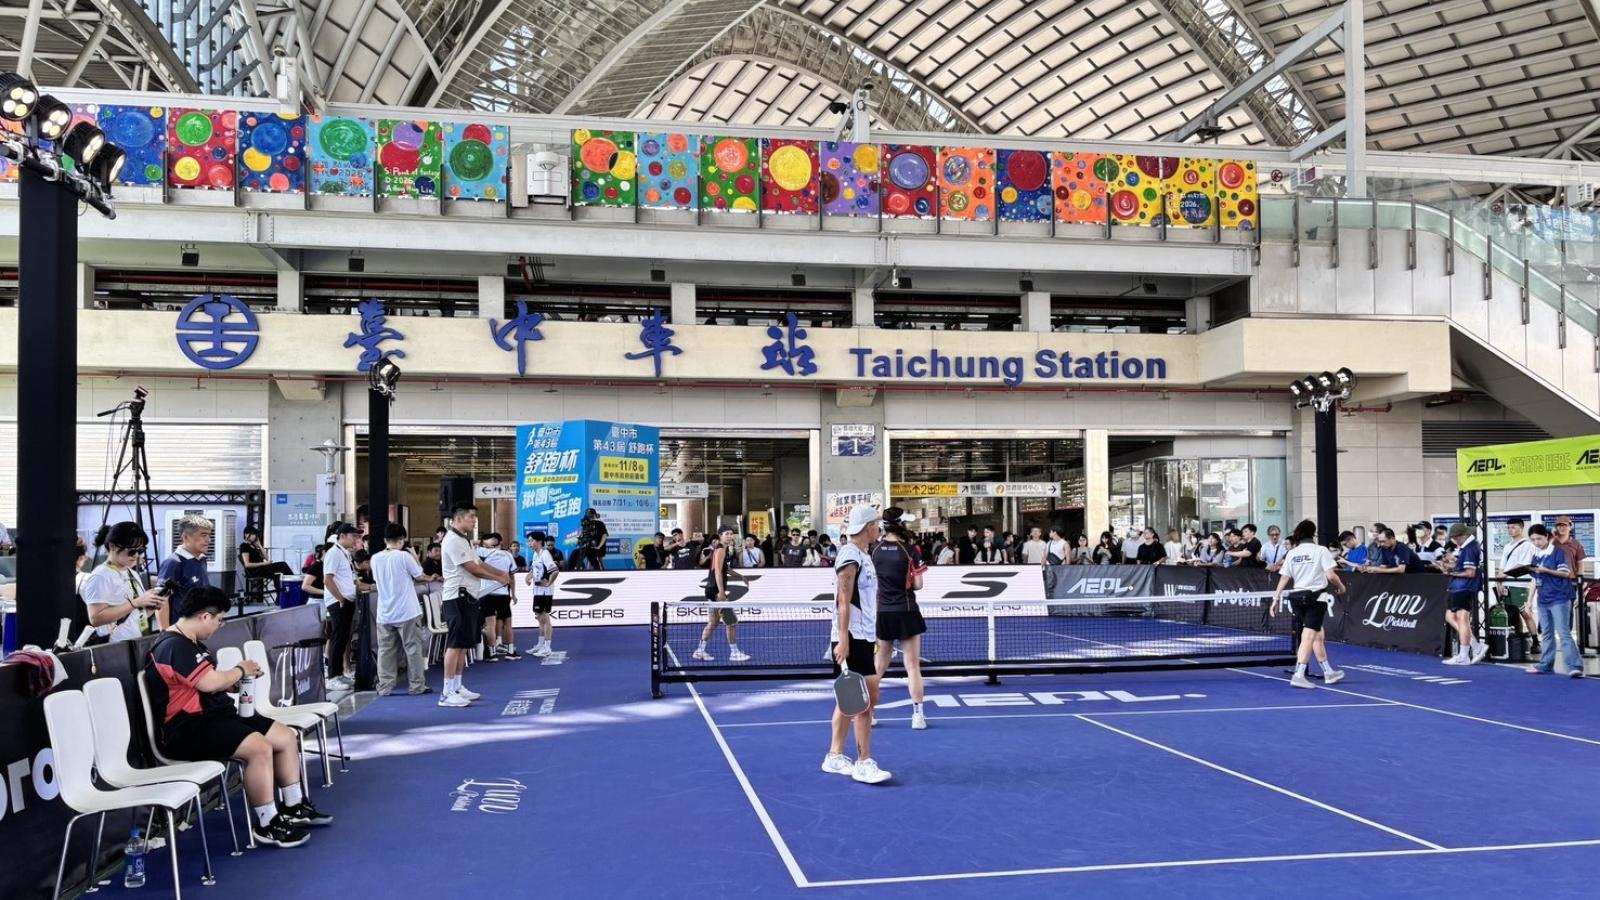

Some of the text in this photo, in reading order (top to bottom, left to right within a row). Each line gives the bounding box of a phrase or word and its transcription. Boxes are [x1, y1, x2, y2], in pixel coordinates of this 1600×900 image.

[849, 348, 1167, 386] Taichung Station
[548, 608, 625, 620] KECHERS
